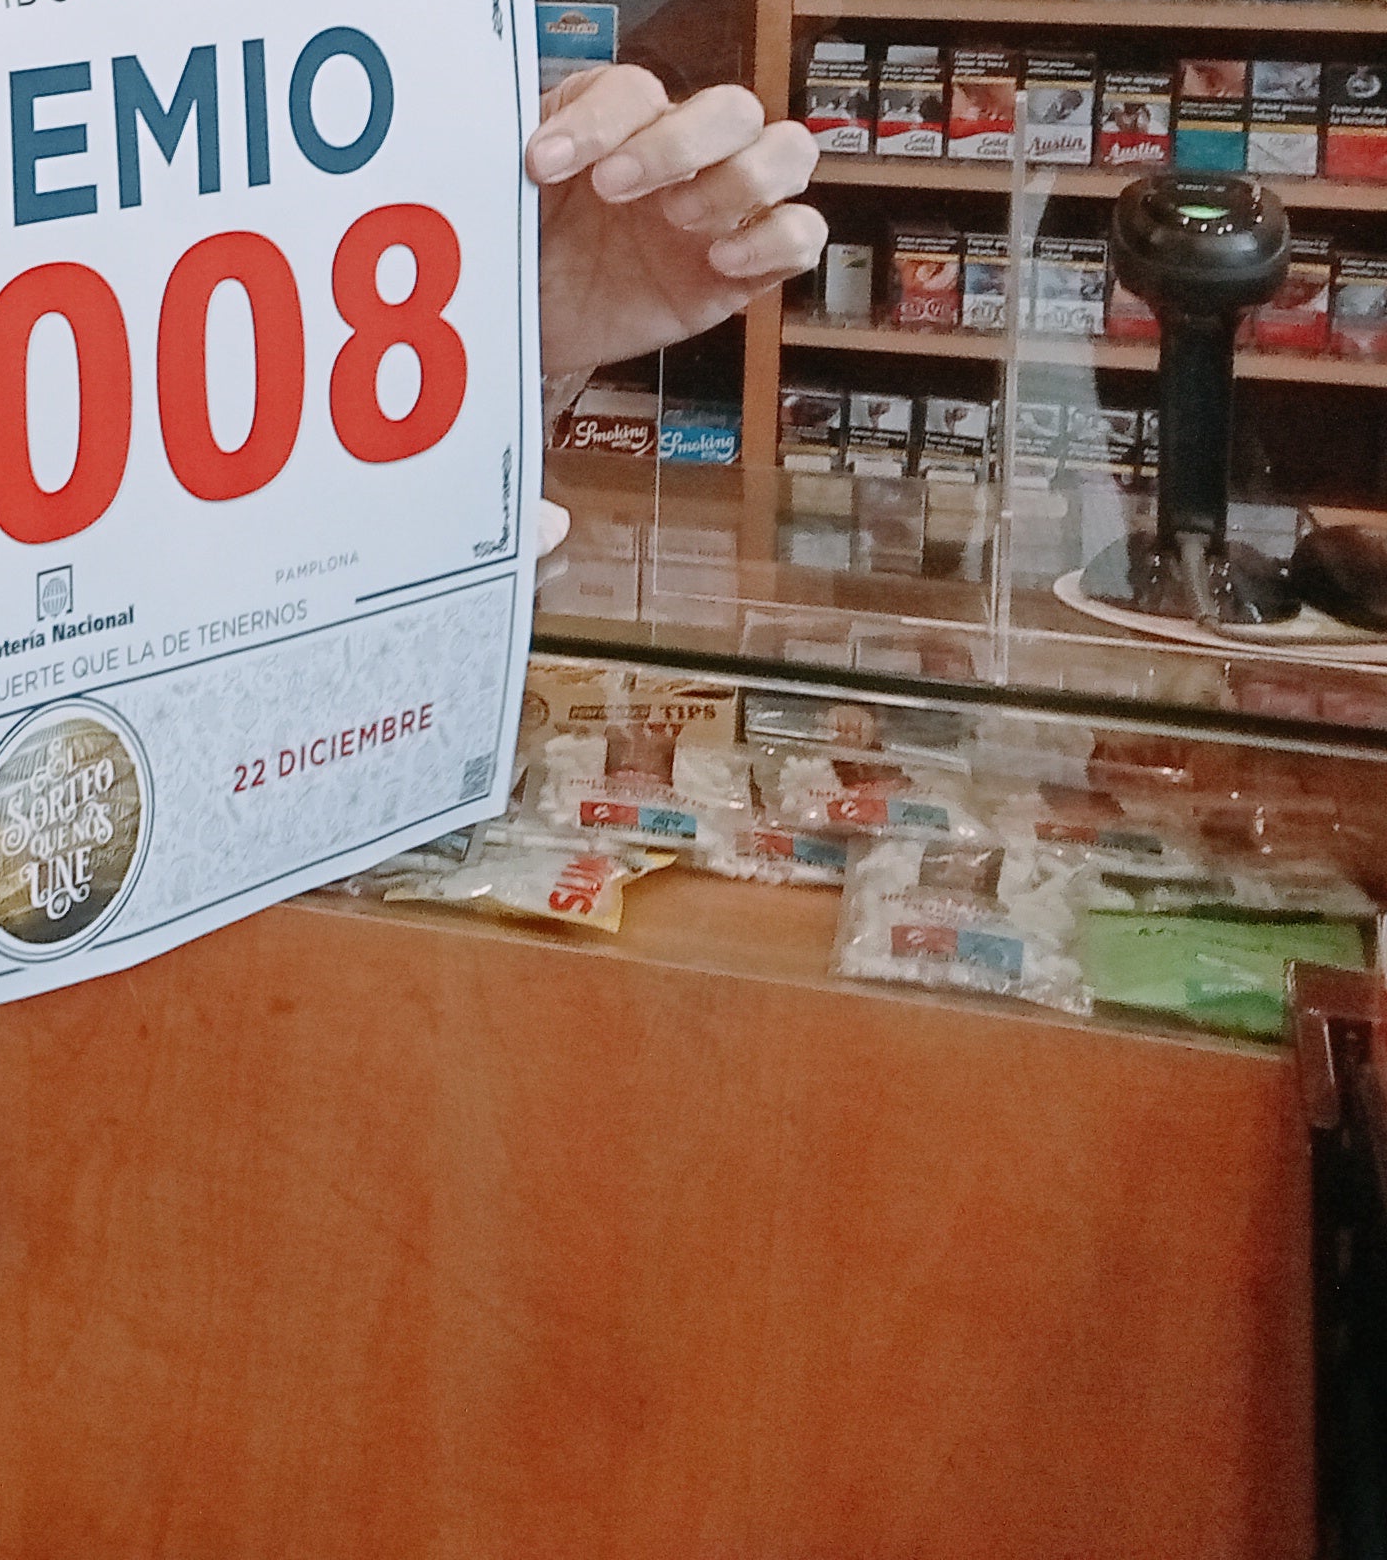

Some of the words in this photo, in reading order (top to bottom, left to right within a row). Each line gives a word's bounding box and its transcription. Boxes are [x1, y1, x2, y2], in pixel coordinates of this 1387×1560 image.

[1027, 135, 1087, 155] Austin
[1102, 141, 1165, 166] Austin
[574, 419, 653, 456] Smoking
[659, 430, 740, 464] Smoking
[275, 550, 360, 584] PAMPLONA
[52, 603, 136, 643] Nacional
[72, 646, 121, 681] QUE
[127, 638, 156, 666] LA
[162, 629, 192, 658] DE
[197, 598, 309, 642] TENERNOS
[660, 704, 717, 720] TIPS
[232, 758, 267, 794] 22
[278, 702, 435, 778] DICIEMBRE
[1, 757, 116, 856] SORTEO
[30, 824, 70, 861] QUE
[71, 800, 115, 845] NOS
[19, 846, 94, 920] UNE
